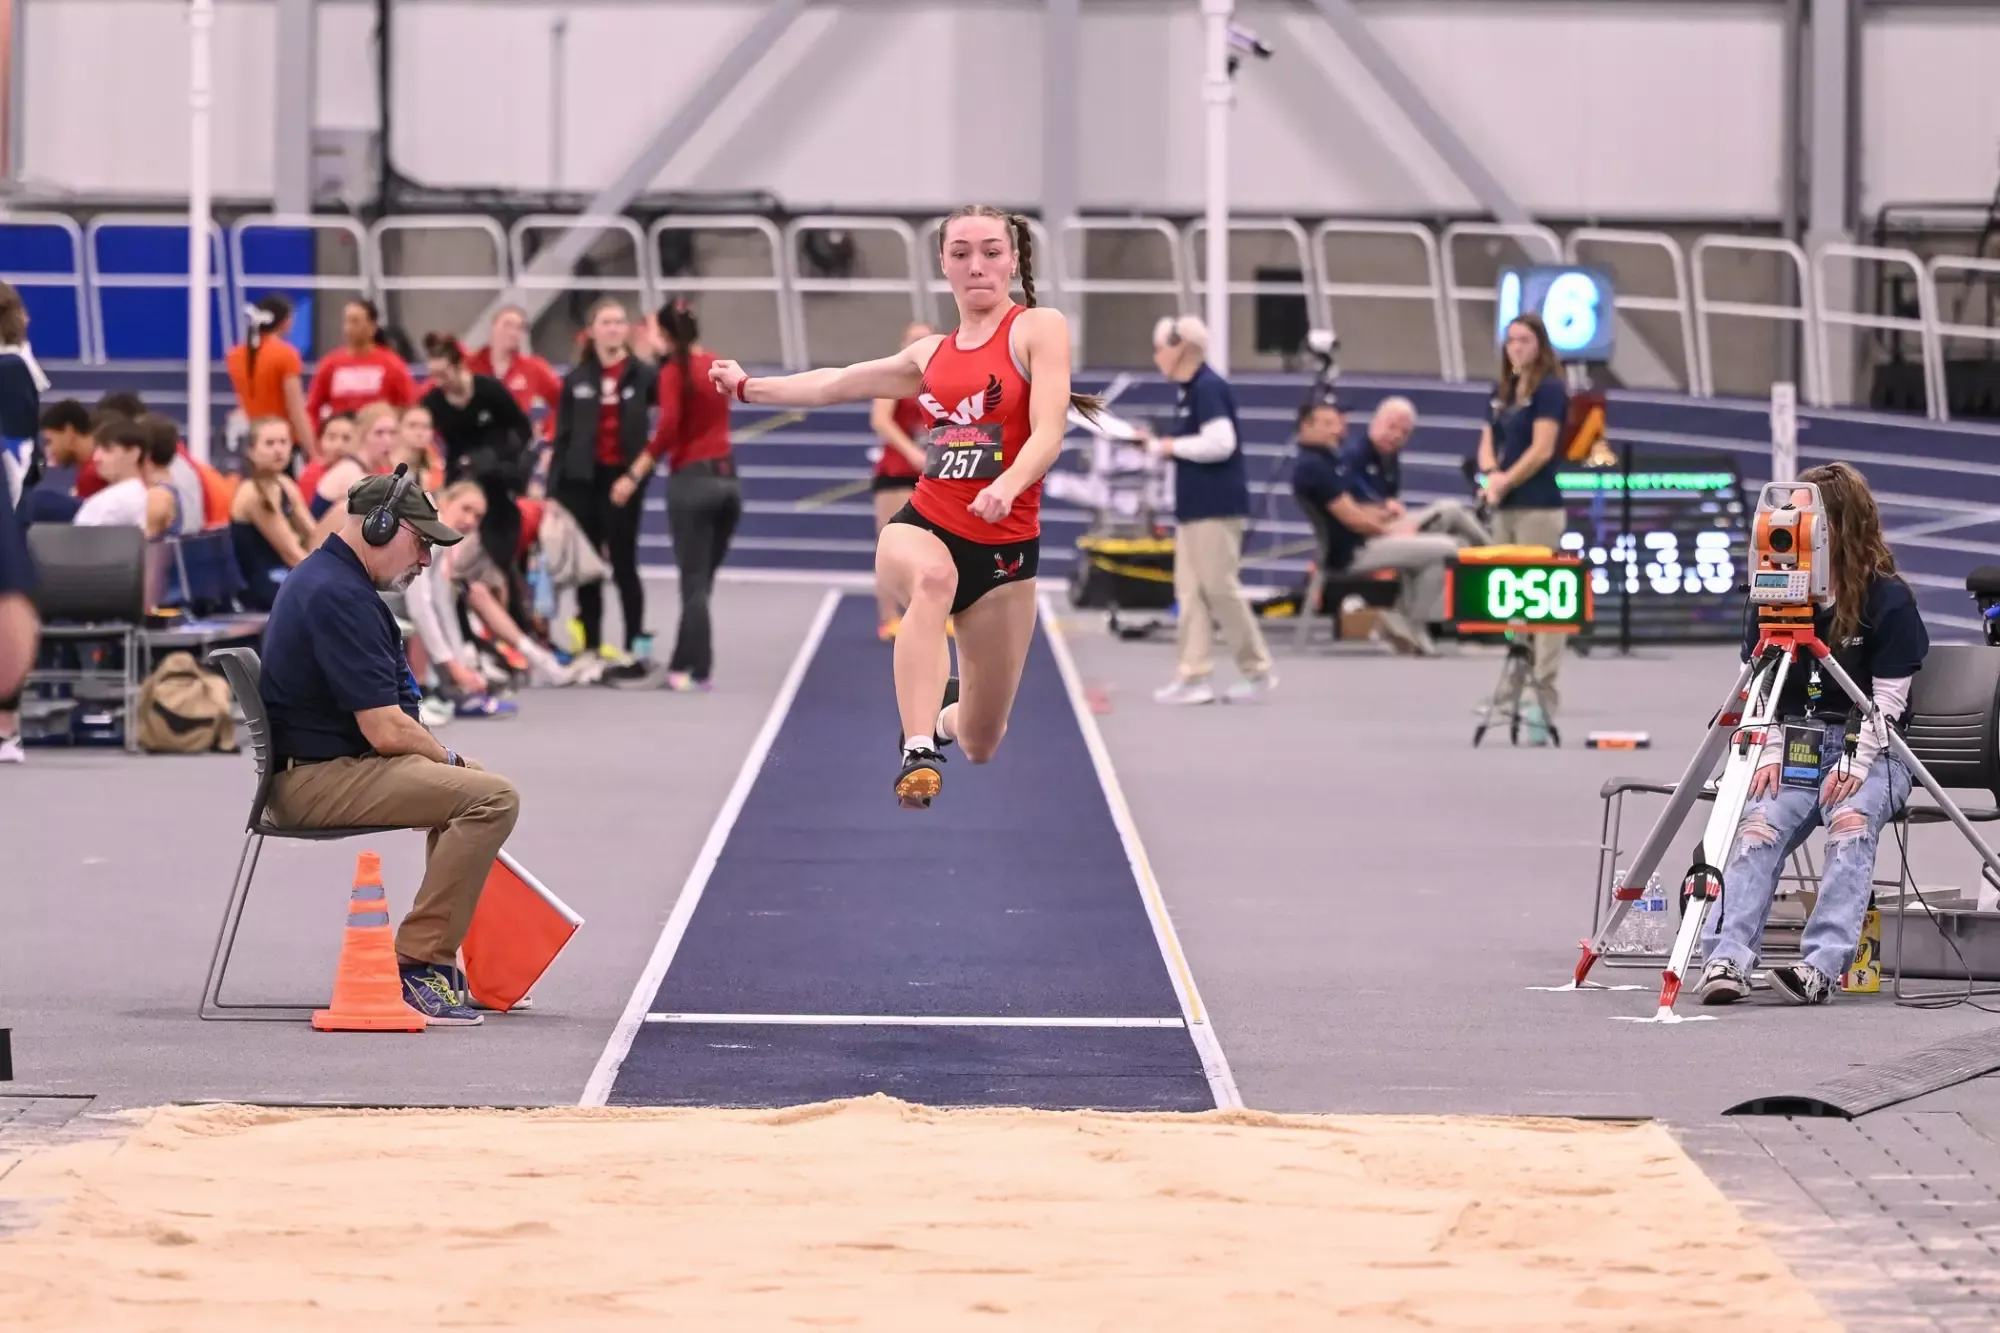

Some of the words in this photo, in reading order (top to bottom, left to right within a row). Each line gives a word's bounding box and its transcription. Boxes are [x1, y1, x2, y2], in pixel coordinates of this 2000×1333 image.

[938, 449, 983, 479] 257
[1487, 568, 1578, 619] 0:50
[1788, 752, 1818, 764] SEASON
